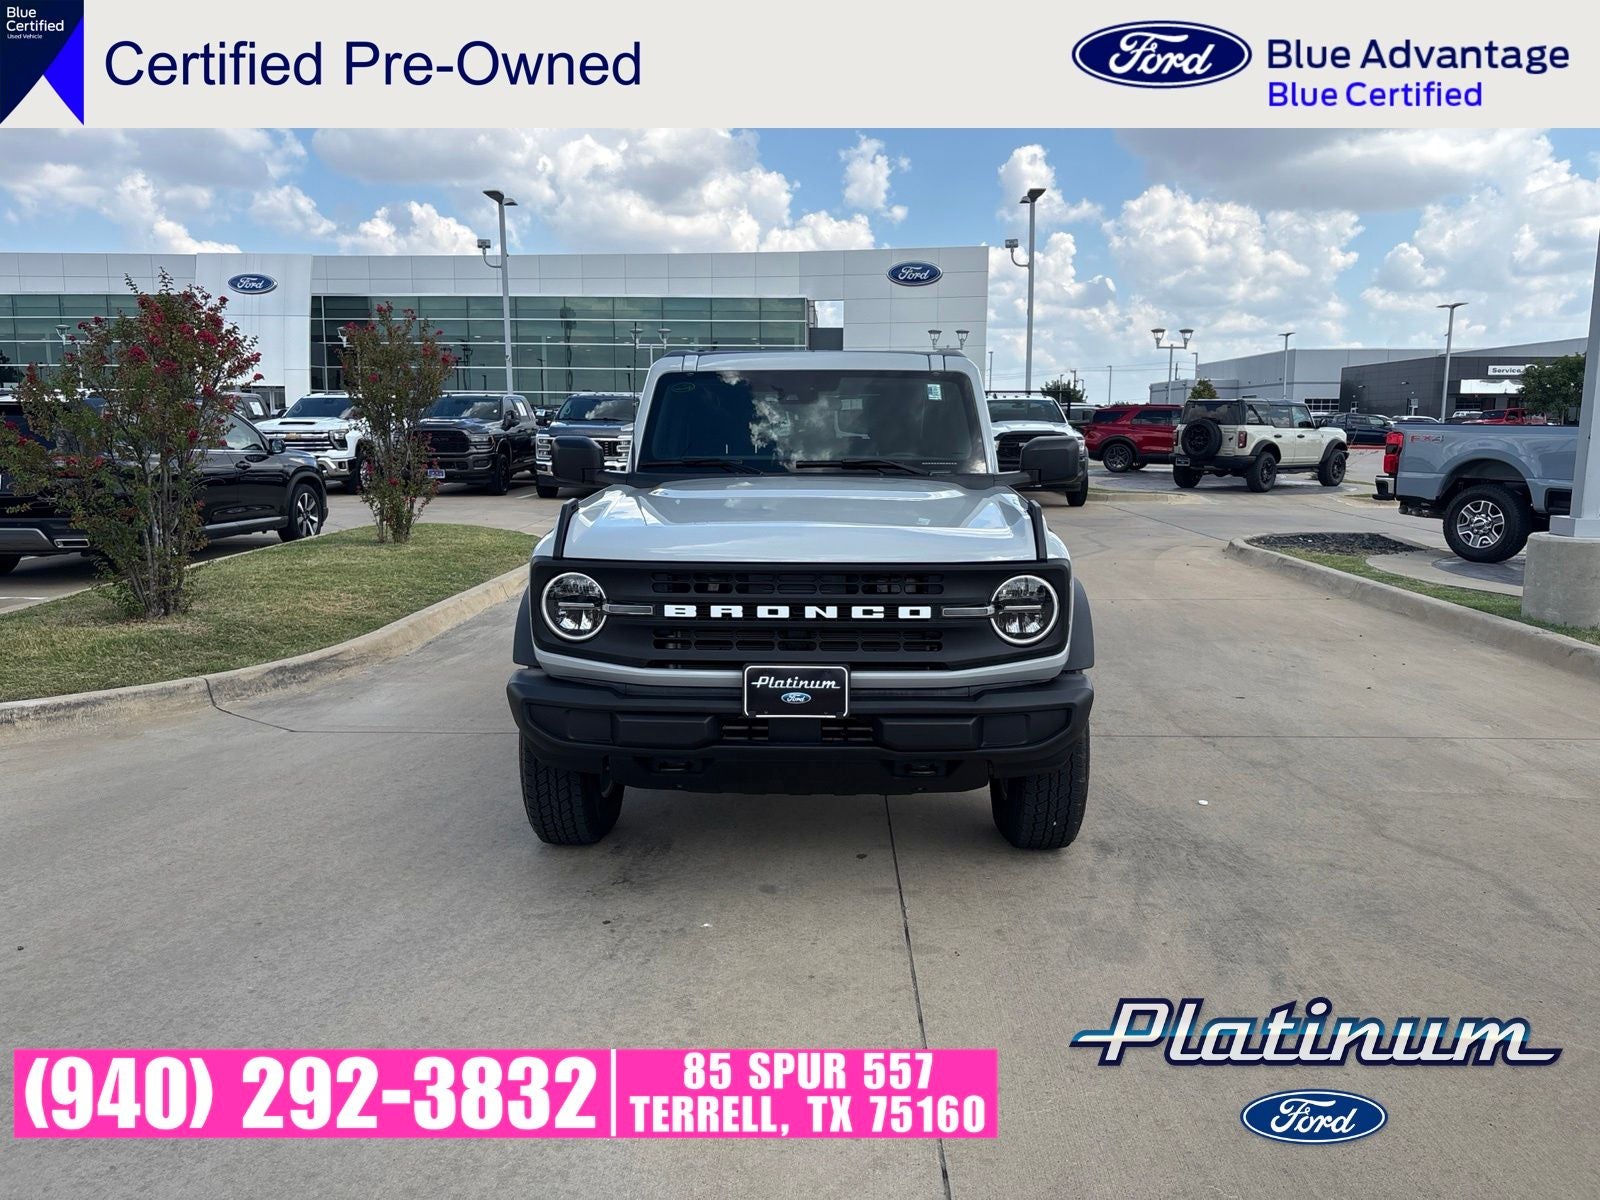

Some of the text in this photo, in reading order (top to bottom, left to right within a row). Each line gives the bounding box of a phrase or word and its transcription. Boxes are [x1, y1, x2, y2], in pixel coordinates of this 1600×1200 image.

[898, 266, 930, 280] Ford
[237, 277, 265, 289] Ford
[664, 604, 932, 619] BRONCO
[751, 675, 841, 689] Platinum
